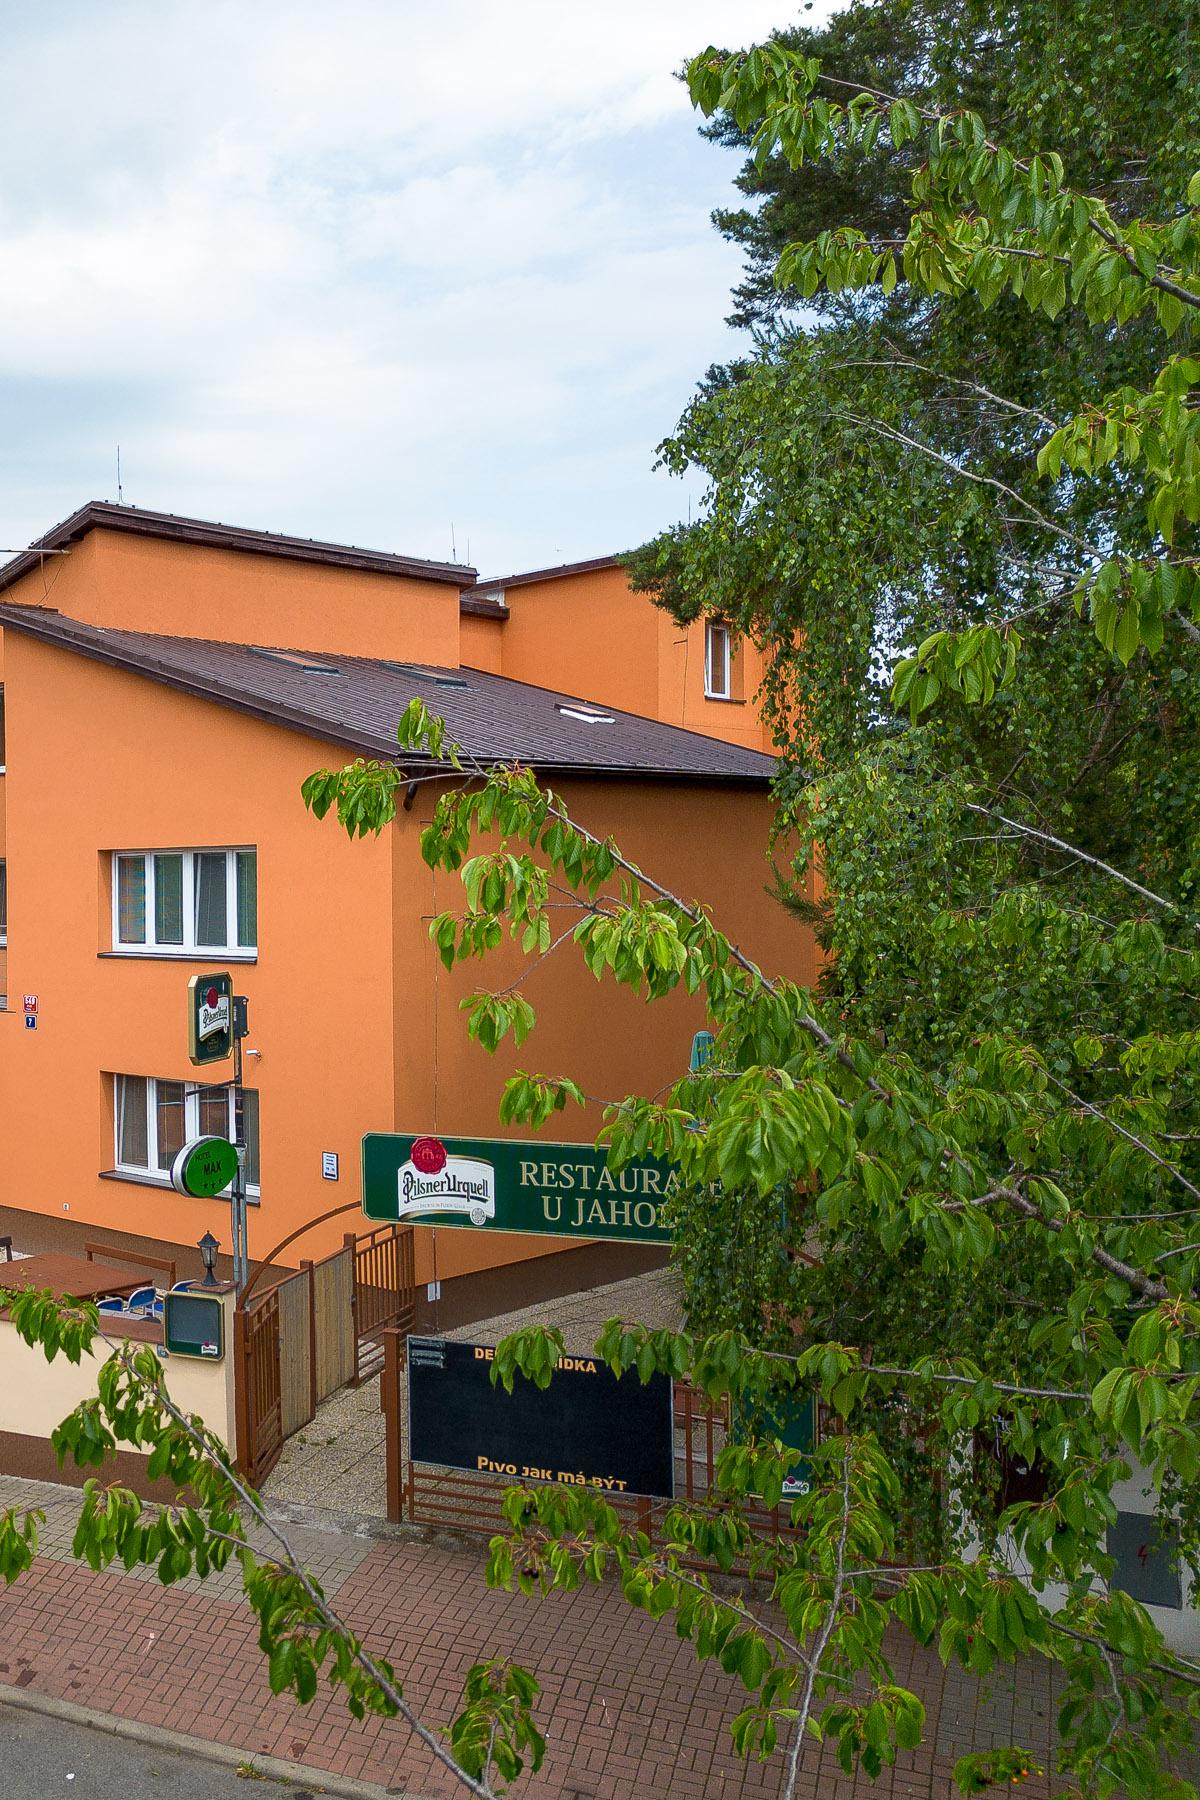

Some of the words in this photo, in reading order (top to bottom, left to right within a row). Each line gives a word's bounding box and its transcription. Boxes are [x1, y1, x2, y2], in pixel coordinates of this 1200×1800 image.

[203, 1160, 222, 1177] MAX
[402, 1170, 448, 1204] Pilsner
[445, 1172, 489, 1202] Urquell
[541, 1195, 563, 1221] U
[557, 1471, 586, 1486] má
